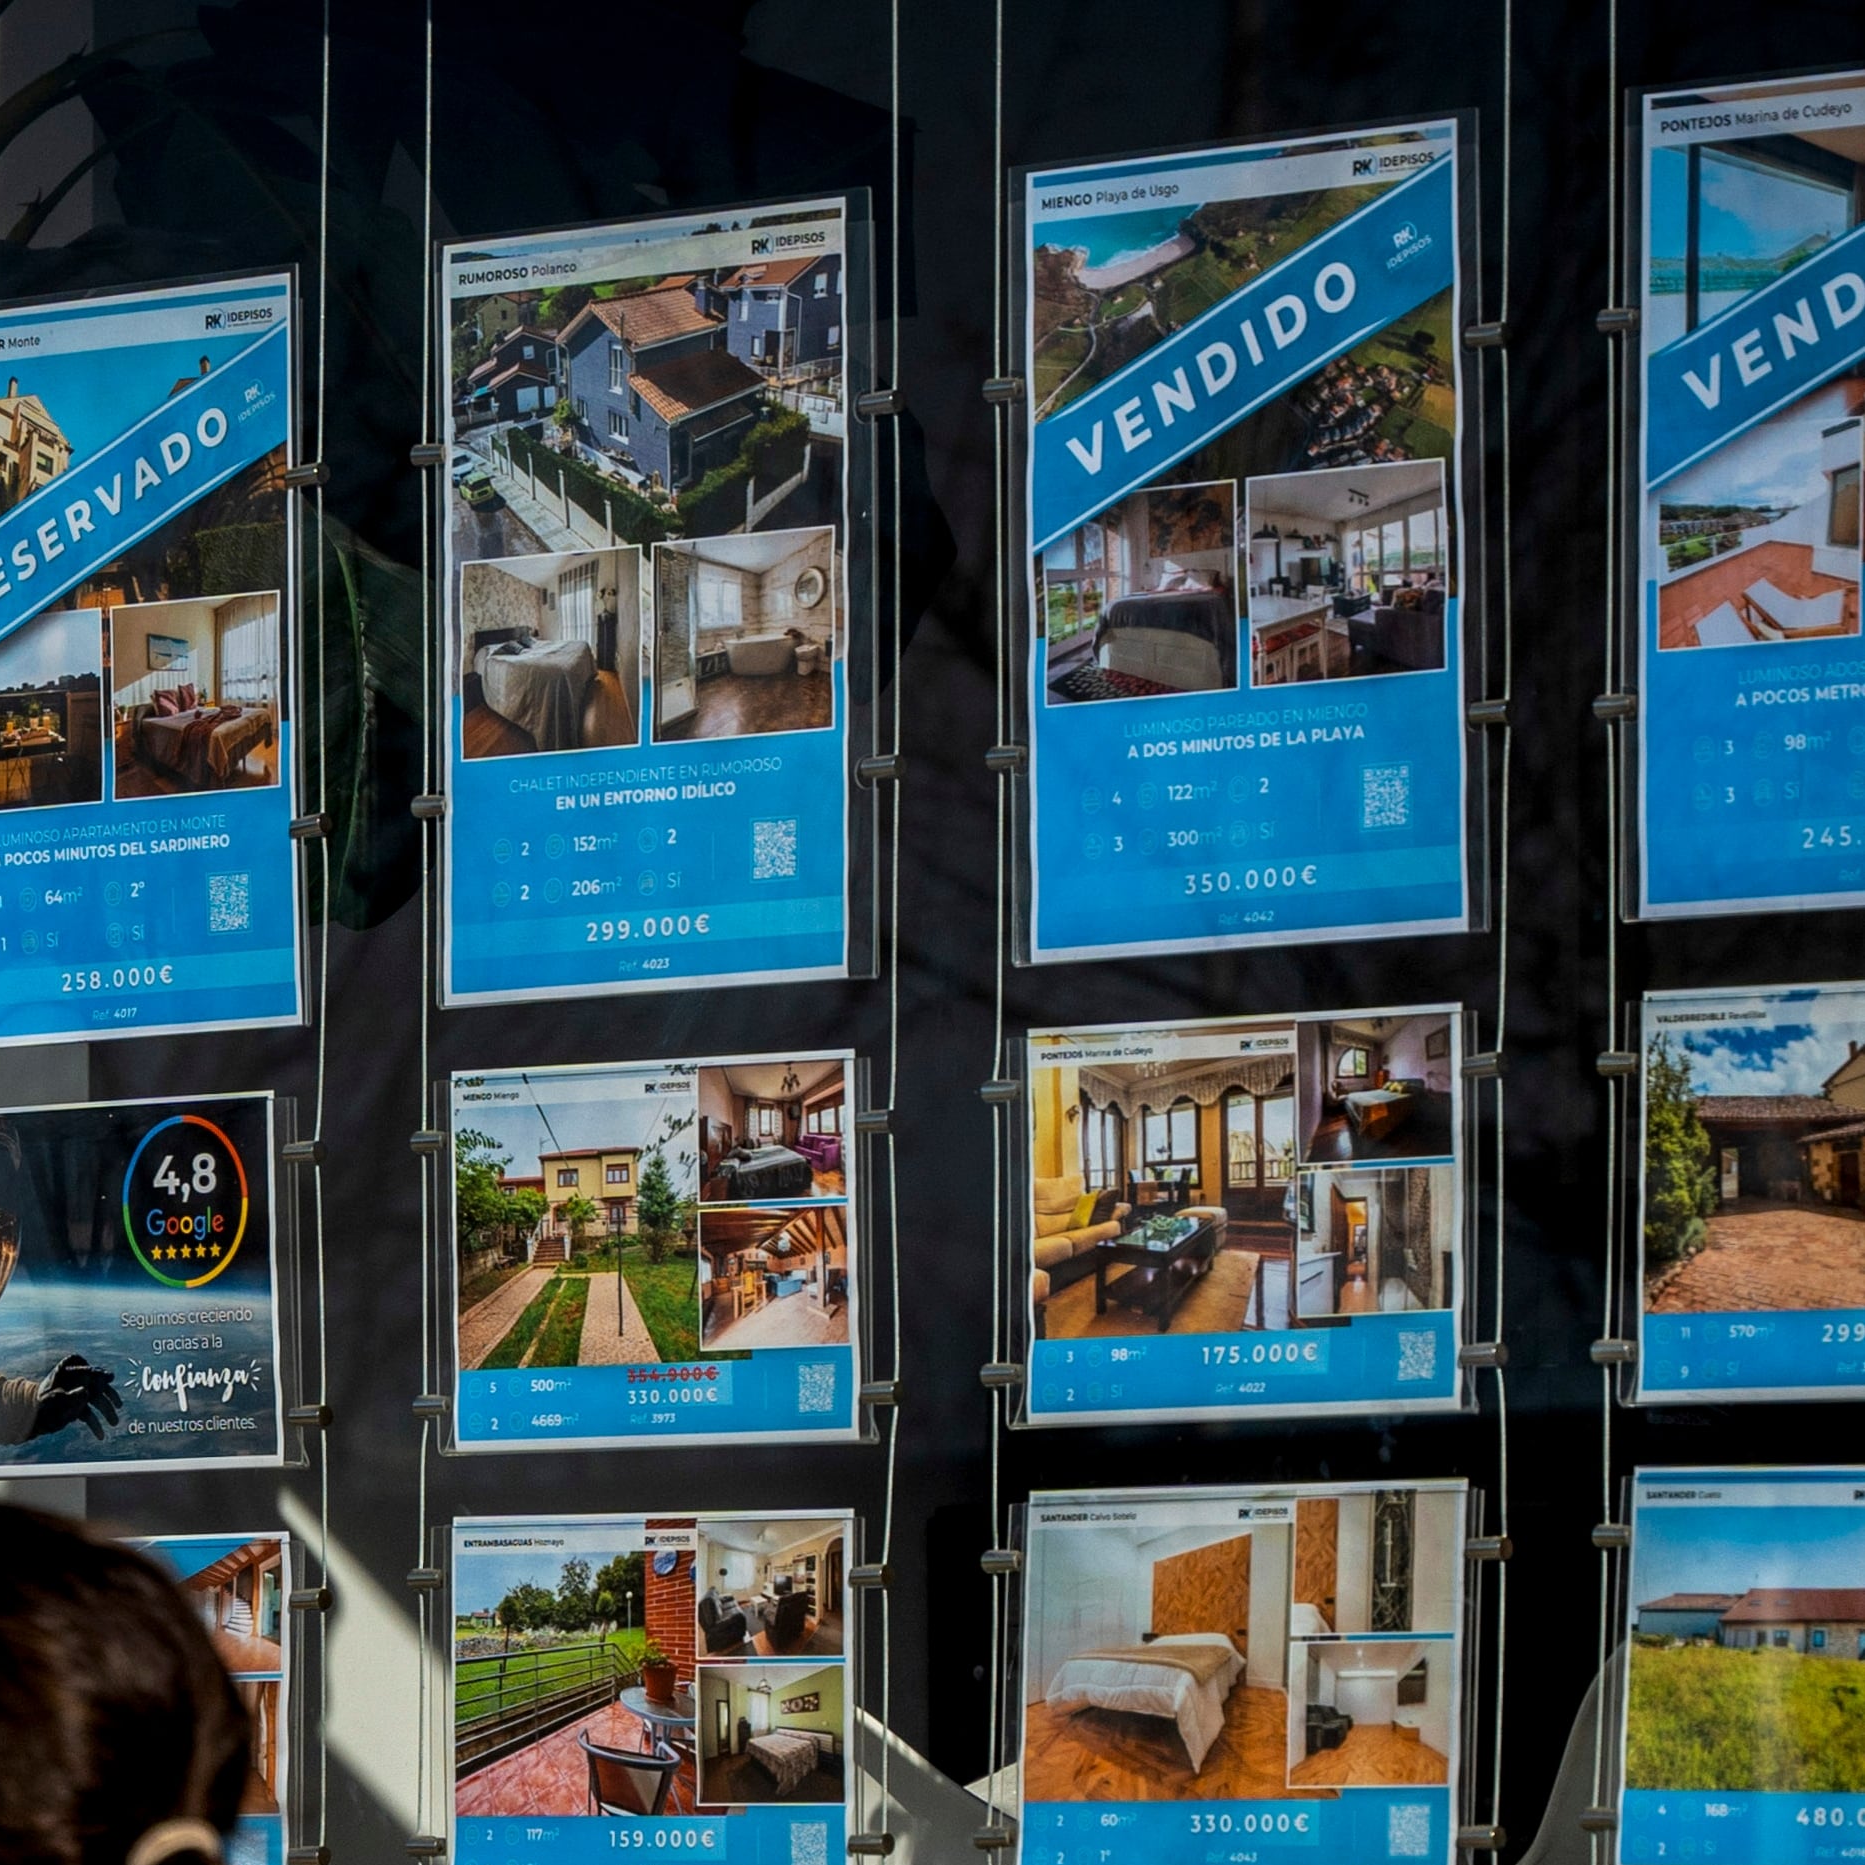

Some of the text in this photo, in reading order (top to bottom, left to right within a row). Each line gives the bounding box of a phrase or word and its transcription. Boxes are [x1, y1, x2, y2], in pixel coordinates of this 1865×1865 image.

[1660, 101, 1852, 134] PONTEJOS Marina de Cudeyo
[1352, 150, 1434, 177] RK IDEPISOS
[1041, 182, 1180, 211] MIENGO Playa de Usgo
[751, 230, 825, 256] RK IDEPISOS
[458, 260, 577, 286] RUMOROSO Polanco
[205, 307, 273, 330] RK IDEPISOS
[8, 335, 41, 350] Monte
[1065, 261, 1357, 477] VENDIDO
[1127, 723, 1366, 759] A DOS MINUTOS DE LA PLAYA
[555, 779, 736, 812] EN UN ENTORNO IDÍLICO
[4, 849, 50, 866] POCOS
[54, 843, 116, 862] MINUTOS
[119, 840, 146, 857] DEL
[150, 834, 230, 854] SARDINERO
[1184, 864, 1318, 895] 350.000€
[586, 913, 711, 943] 299.000€
[1243, 909, 1275, 923] 4042
[642, 957, 670, 971] 4023
[61, 964, 174, 993] 258.000€
[113, 1007, 138, 1019] 4017
[462, 1092, 492, 1101] MIENGO
[152, 1152, 218, 1204] 4,8
[146, 1205, 225, 1240] Google
[120, 1306, 253, 1331] Seguimos creciendo
[152, 1334, 223, 1356] gracias a la
[1201, 1342, 1319, 1367] 175.000€
[141, 1358, 252, 1412] Confianza
[627, 1386, 718, 1405] 330.000€
[128, 1414, 257, 1434] de nuestros clientes.
[1040, 1512, 1089, 1523] SANTANDER
[1189, 1812, 1310, 1836] 330.000€
[609, 1828, 715, 1850] 159.000€
